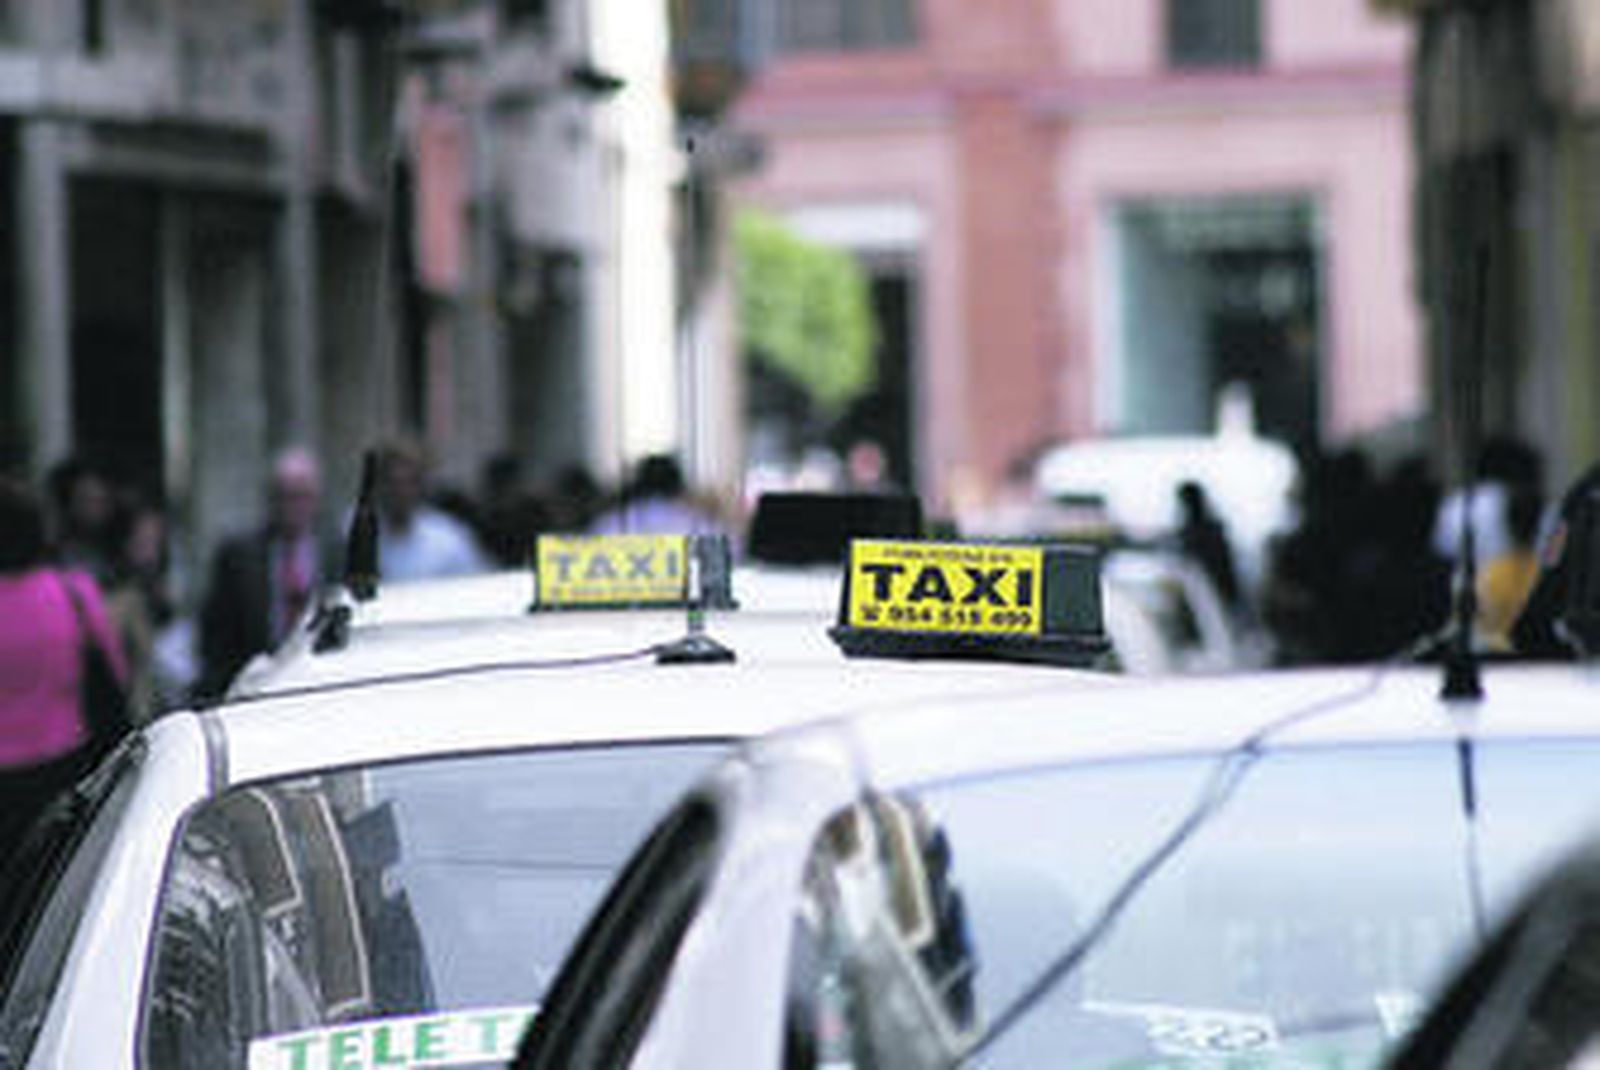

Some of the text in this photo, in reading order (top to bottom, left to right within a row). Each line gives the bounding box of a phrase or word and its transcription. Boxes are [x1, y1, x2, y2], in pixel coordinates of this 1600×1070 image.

[547, 551, 678, 581] TAXI
[860, 564, 1033, 607] TAXI
[277, 1021, 446, 1070] TELE
